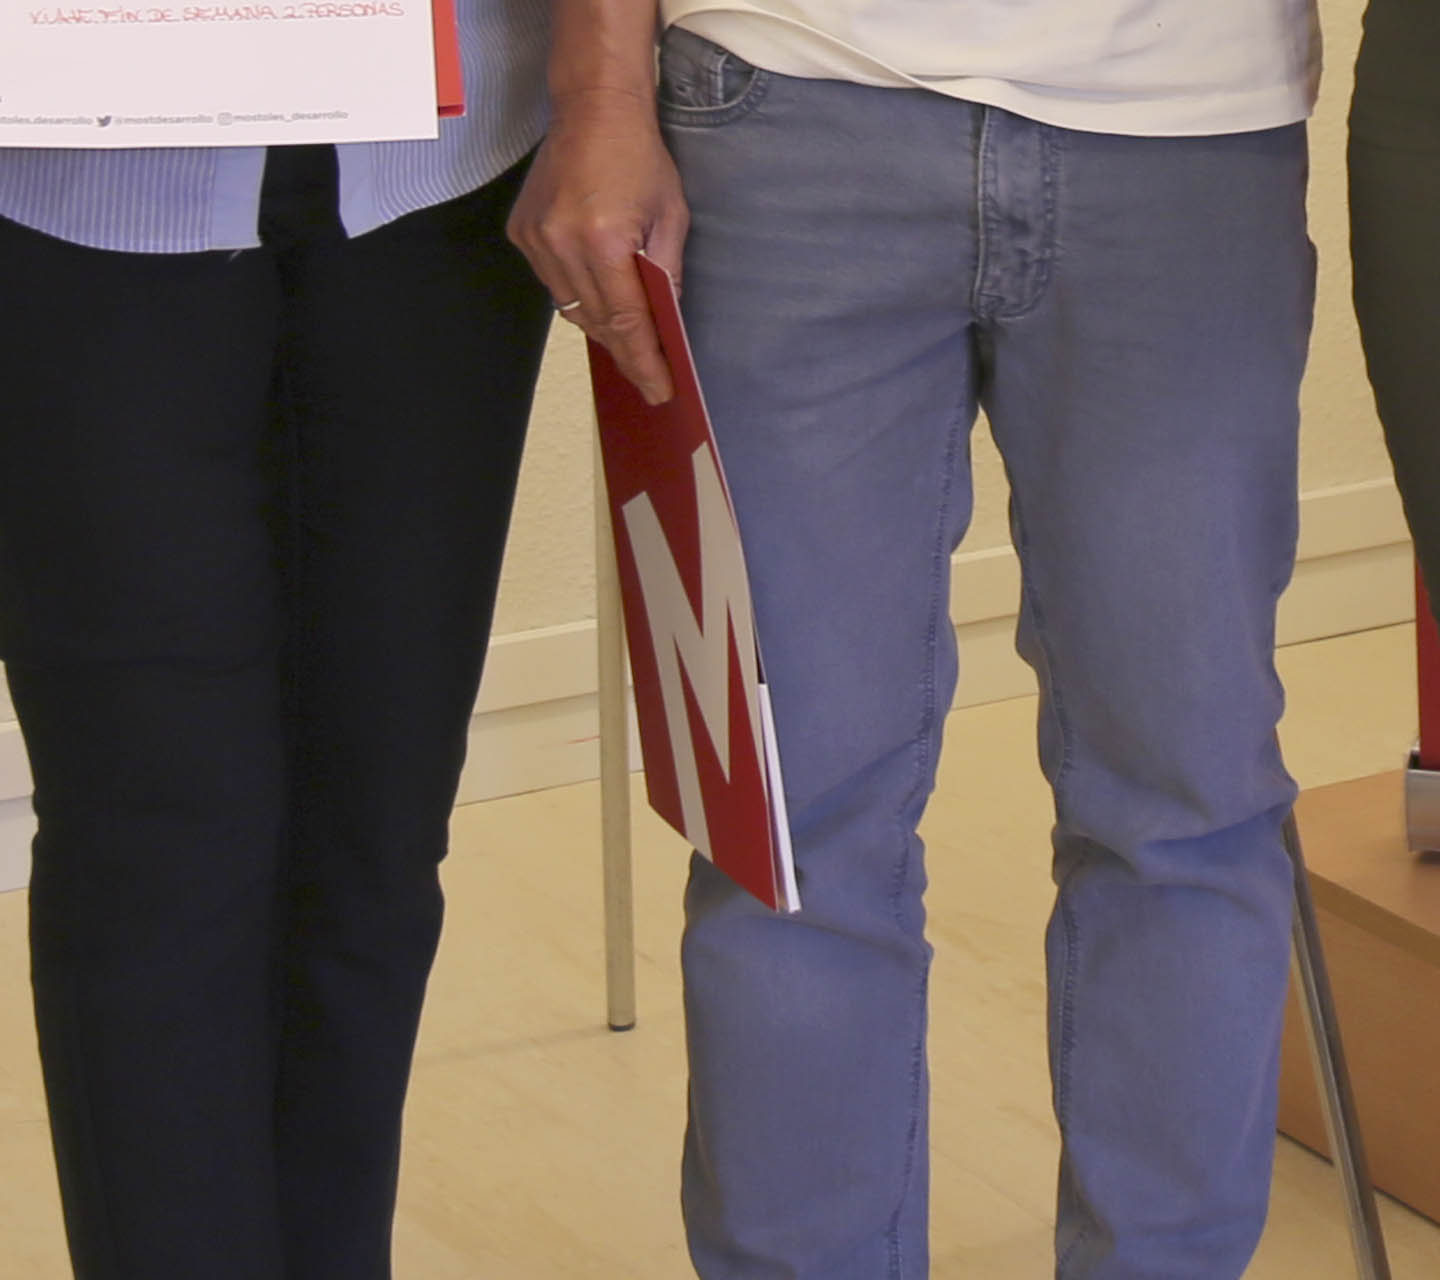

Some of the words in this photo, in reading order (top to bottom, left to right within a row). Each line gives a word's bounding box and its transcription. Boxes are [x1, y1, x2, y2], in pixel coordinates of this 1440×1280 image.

[148, 8, 181, 24] DE
[182, 4, 278, 23] SEMANA
[298, 0, 406, 19] PERSONAS
